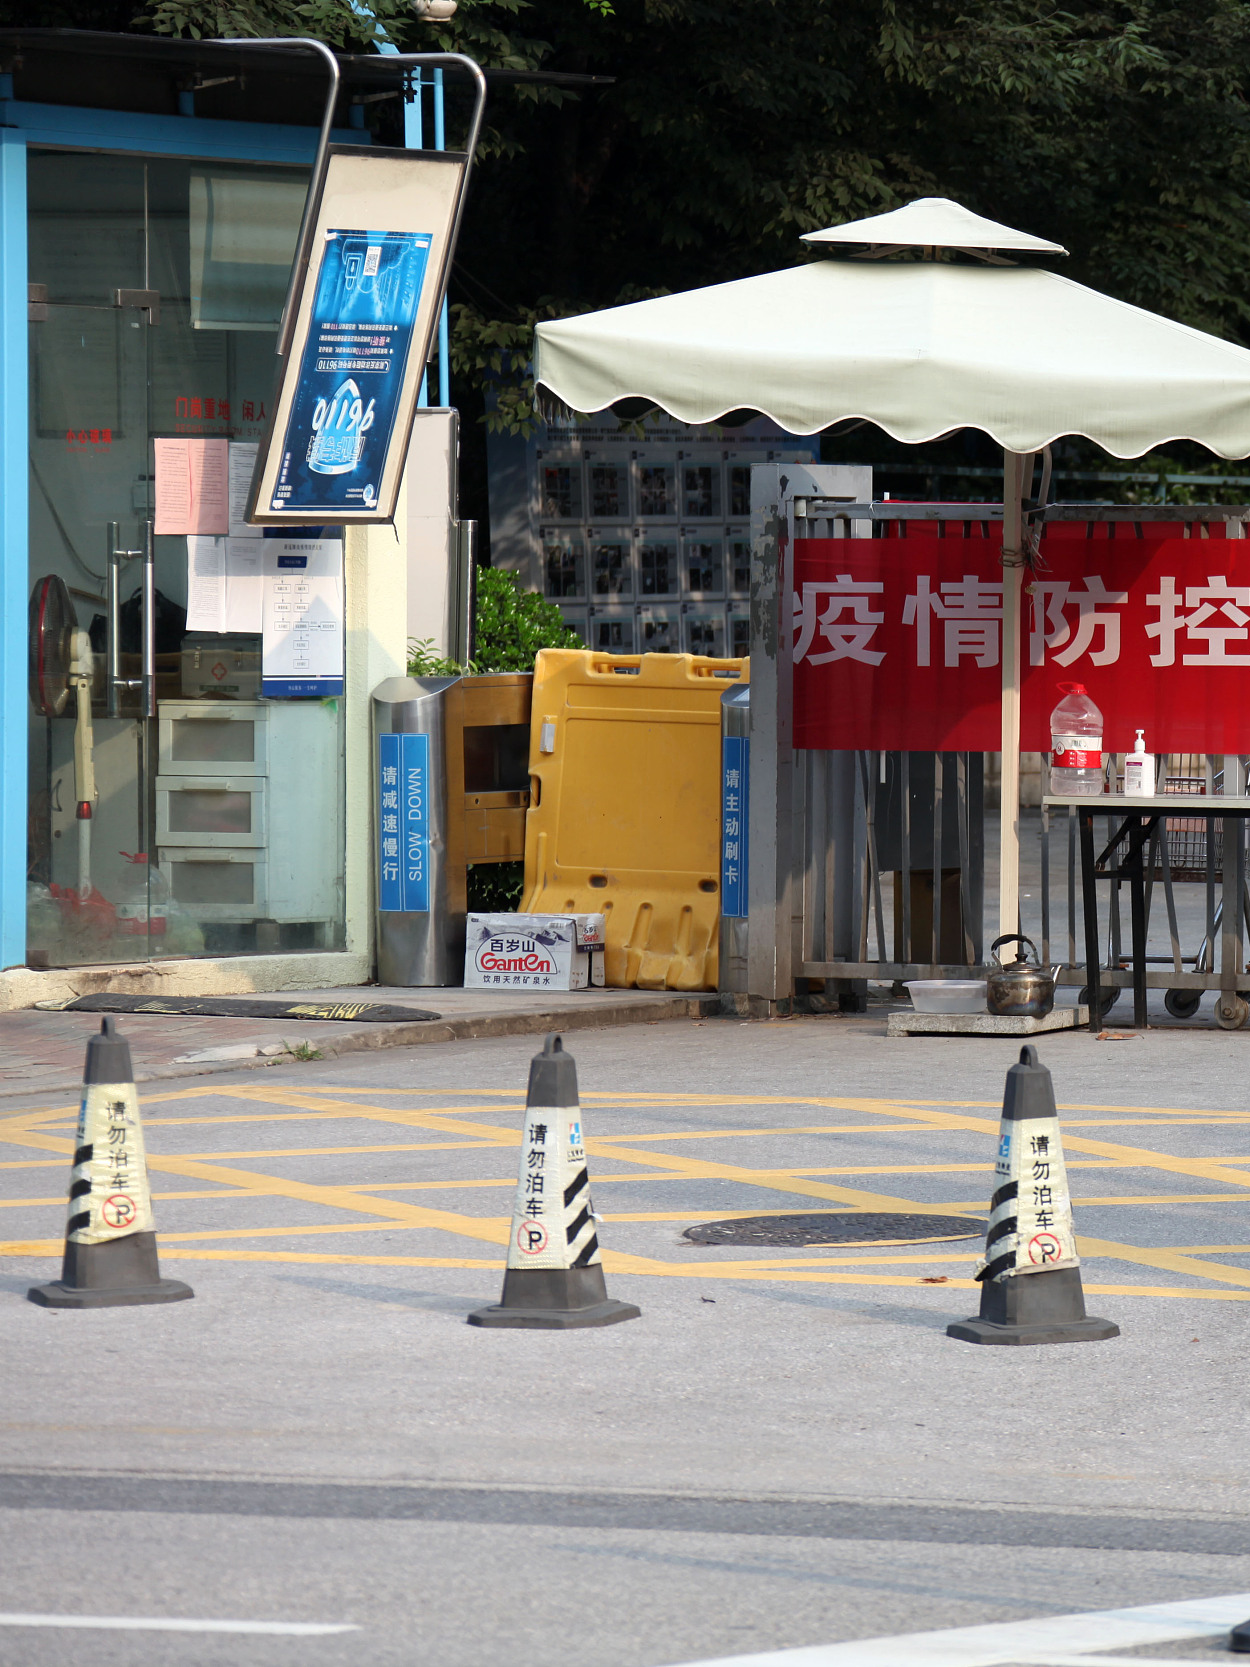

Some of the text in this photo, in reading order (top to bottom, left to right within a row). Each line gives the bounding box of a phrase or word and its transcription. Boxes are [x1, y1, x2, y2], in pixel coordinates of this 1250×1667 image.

[176, 396, 266, 422] 门岗重地 闲人
[312, 398, 375, 431] 96110
[382, 766, 398, 881] 请减速慢行
[408, 767, 422, 882] SLOW DOWN
[724, 768, 740, 885] 请主动刷卡
[490, 939, 535, 953] 百岁山
[483, 974, 551, 985] 饮用天然矿泉水
[106, 1101, 130, 1191] 请勿泊车
[525, 1123, 548, 1218] 请勿泊车
[1030, 1135, 1054, 1230] 请勿泊车
[116, 1204, 131, 1224] P
[528, 1231, 542, 1250] P
